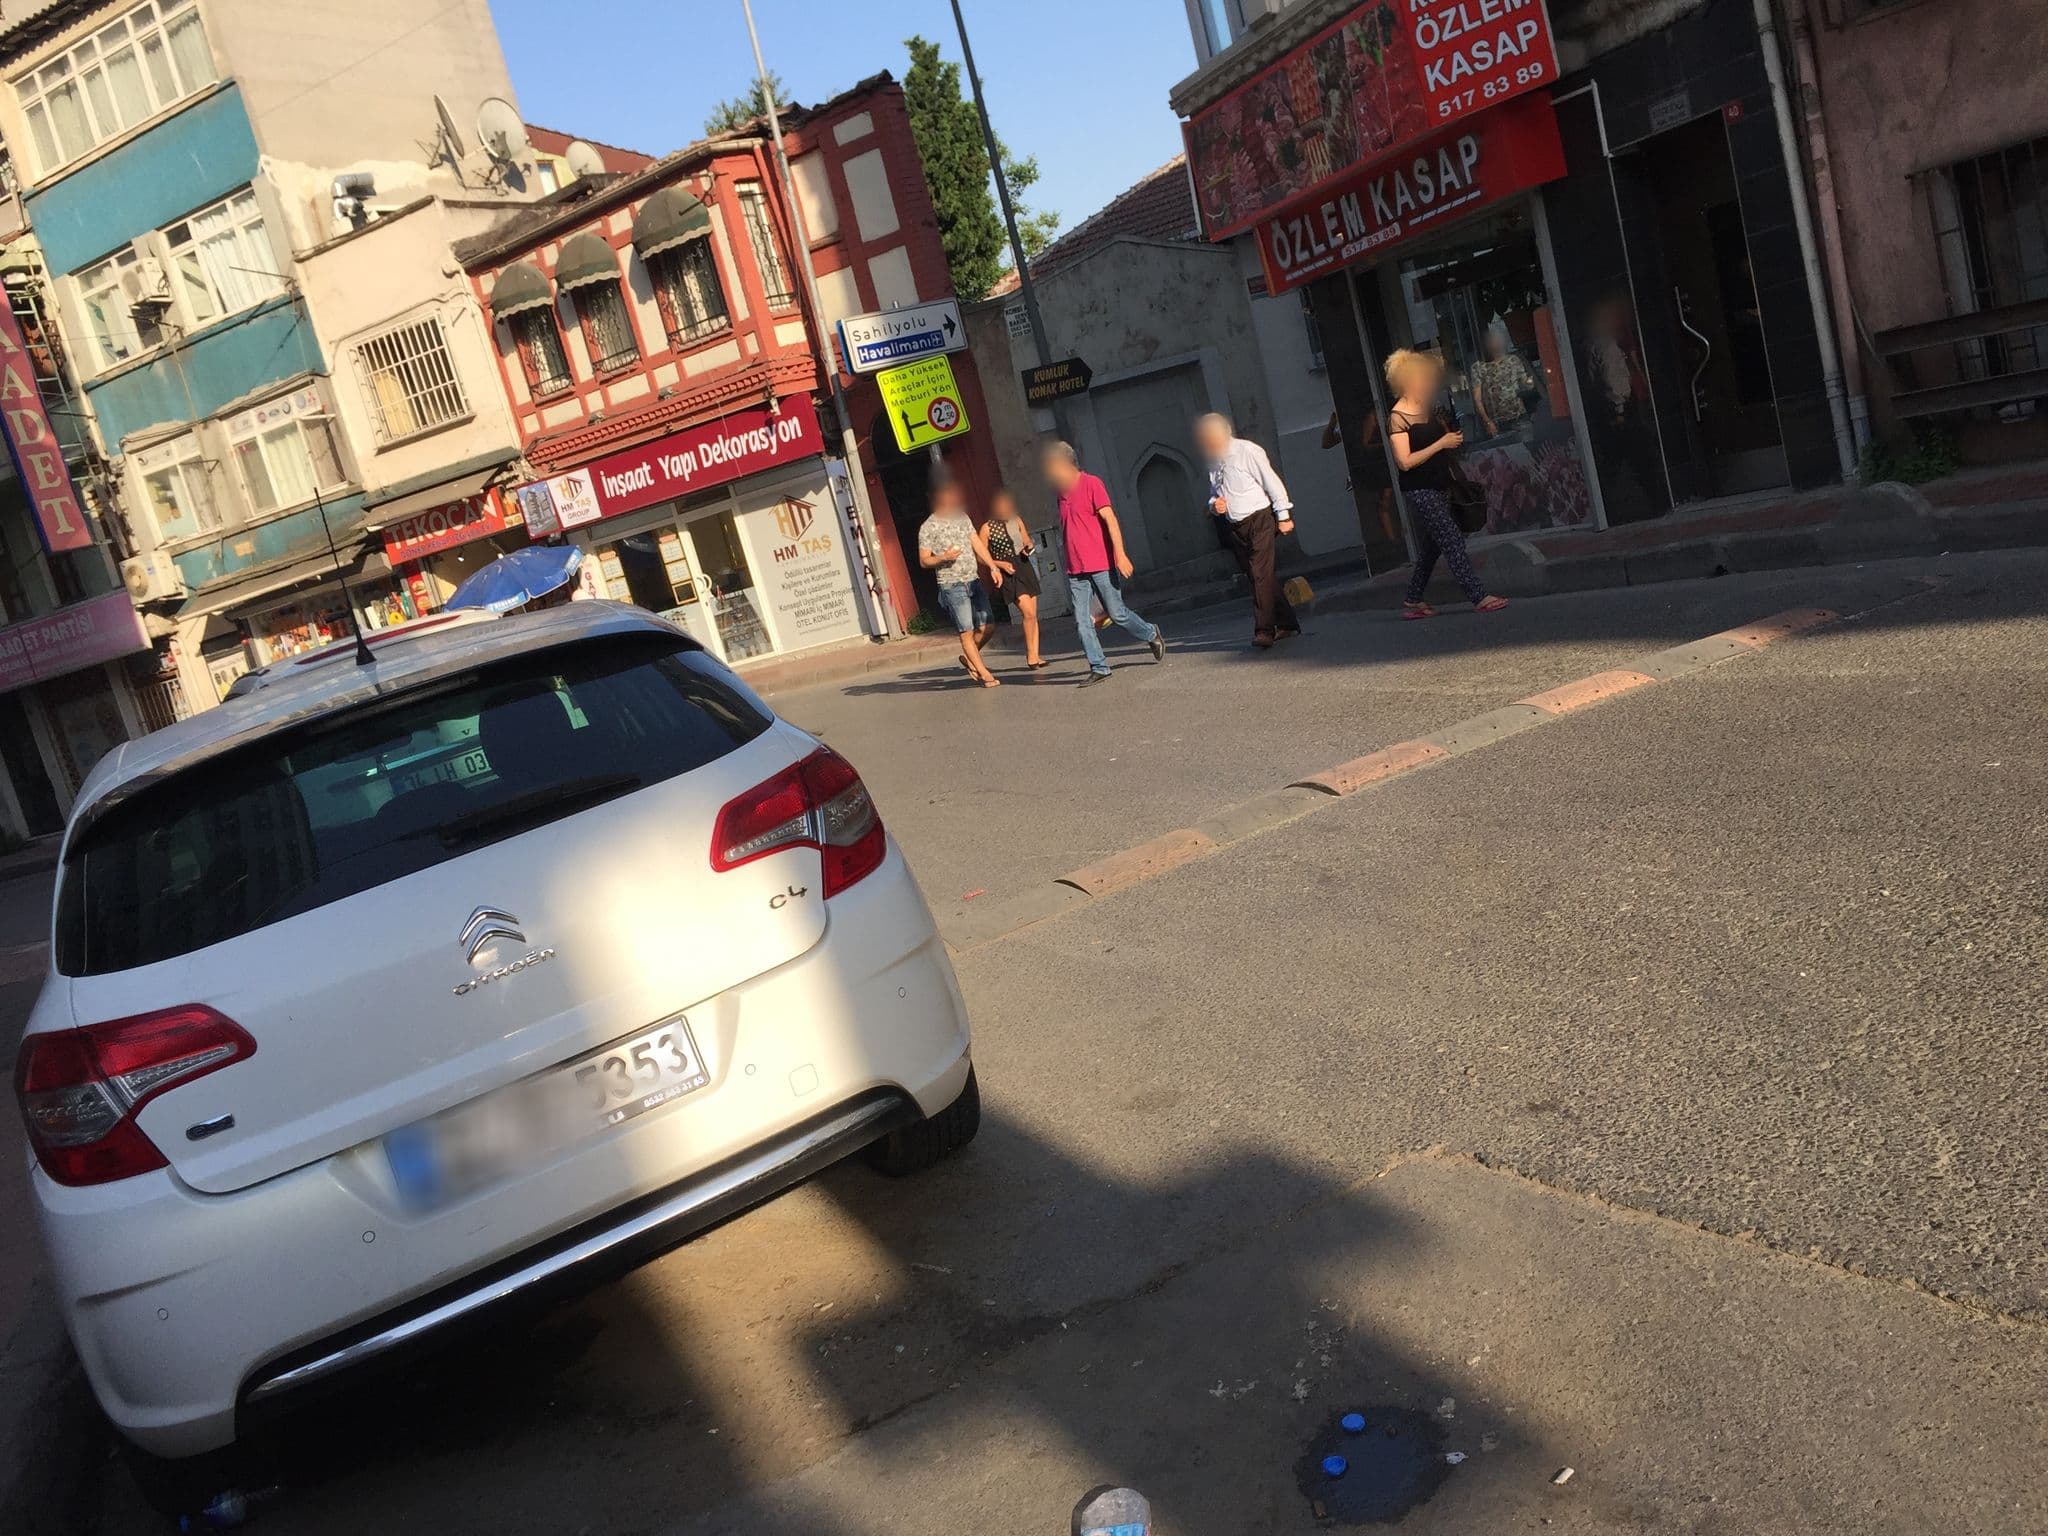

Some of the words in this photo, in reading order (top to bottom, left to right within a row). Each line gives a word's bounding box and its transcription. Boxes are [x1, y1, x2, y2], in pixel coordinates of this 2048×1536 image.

[1424, 19, 1538, 93] KASAP
[1438, 89, 1475, 117] 517
[1483, 76, 1510, 98] 83
[1516, 62, 1543, 84] 89
[1271, 192, 1366, 269] ÖZLEM
[1368, 135, 1479, 226] KASAP
[1345, 242, 1364, 257] 517
[1366, 236, 1381, 248] 83
[1382, 227, 1397, 241] 89
[853, 317, 926, 342] Sahilyolu
[858, 337, 932, 361] Havalimanı
[883, 371, 908, 385] Daha
[909, 362, 945, 376] Yüksek
[889, 380, 925, 395] Araçlar
[927, 373, 946, 387] İçin
[891, 392, 930, 407] Mecburi
[932, 384, 952, 396] Yön
[1029, 383, 1057, 400] KONAK
[1060, 376, 1085, 393] HOTEL
[933, 407, 945, 423] 2
[600, 463, 655, 498] İnşaat
[658, 450, 698, 482] Yapı
[698, 416, 802, 469] Dekorasyon
[560, 503, 575, 513] HM
[567, 509, 589, 519] GROUP
[384, 493, 498, 550] TEKOCAN
[773, 545, 799, 562] HM
[801, 534, 832, 553] TAŞ
[846, 505, 883, 597] EMLAK
[796, 618, 812, 629] OTEL
[813, 611, 833, 623] KONUT
[465, 753, 487, 774] 03
[770, 885, 808, 910] C4
